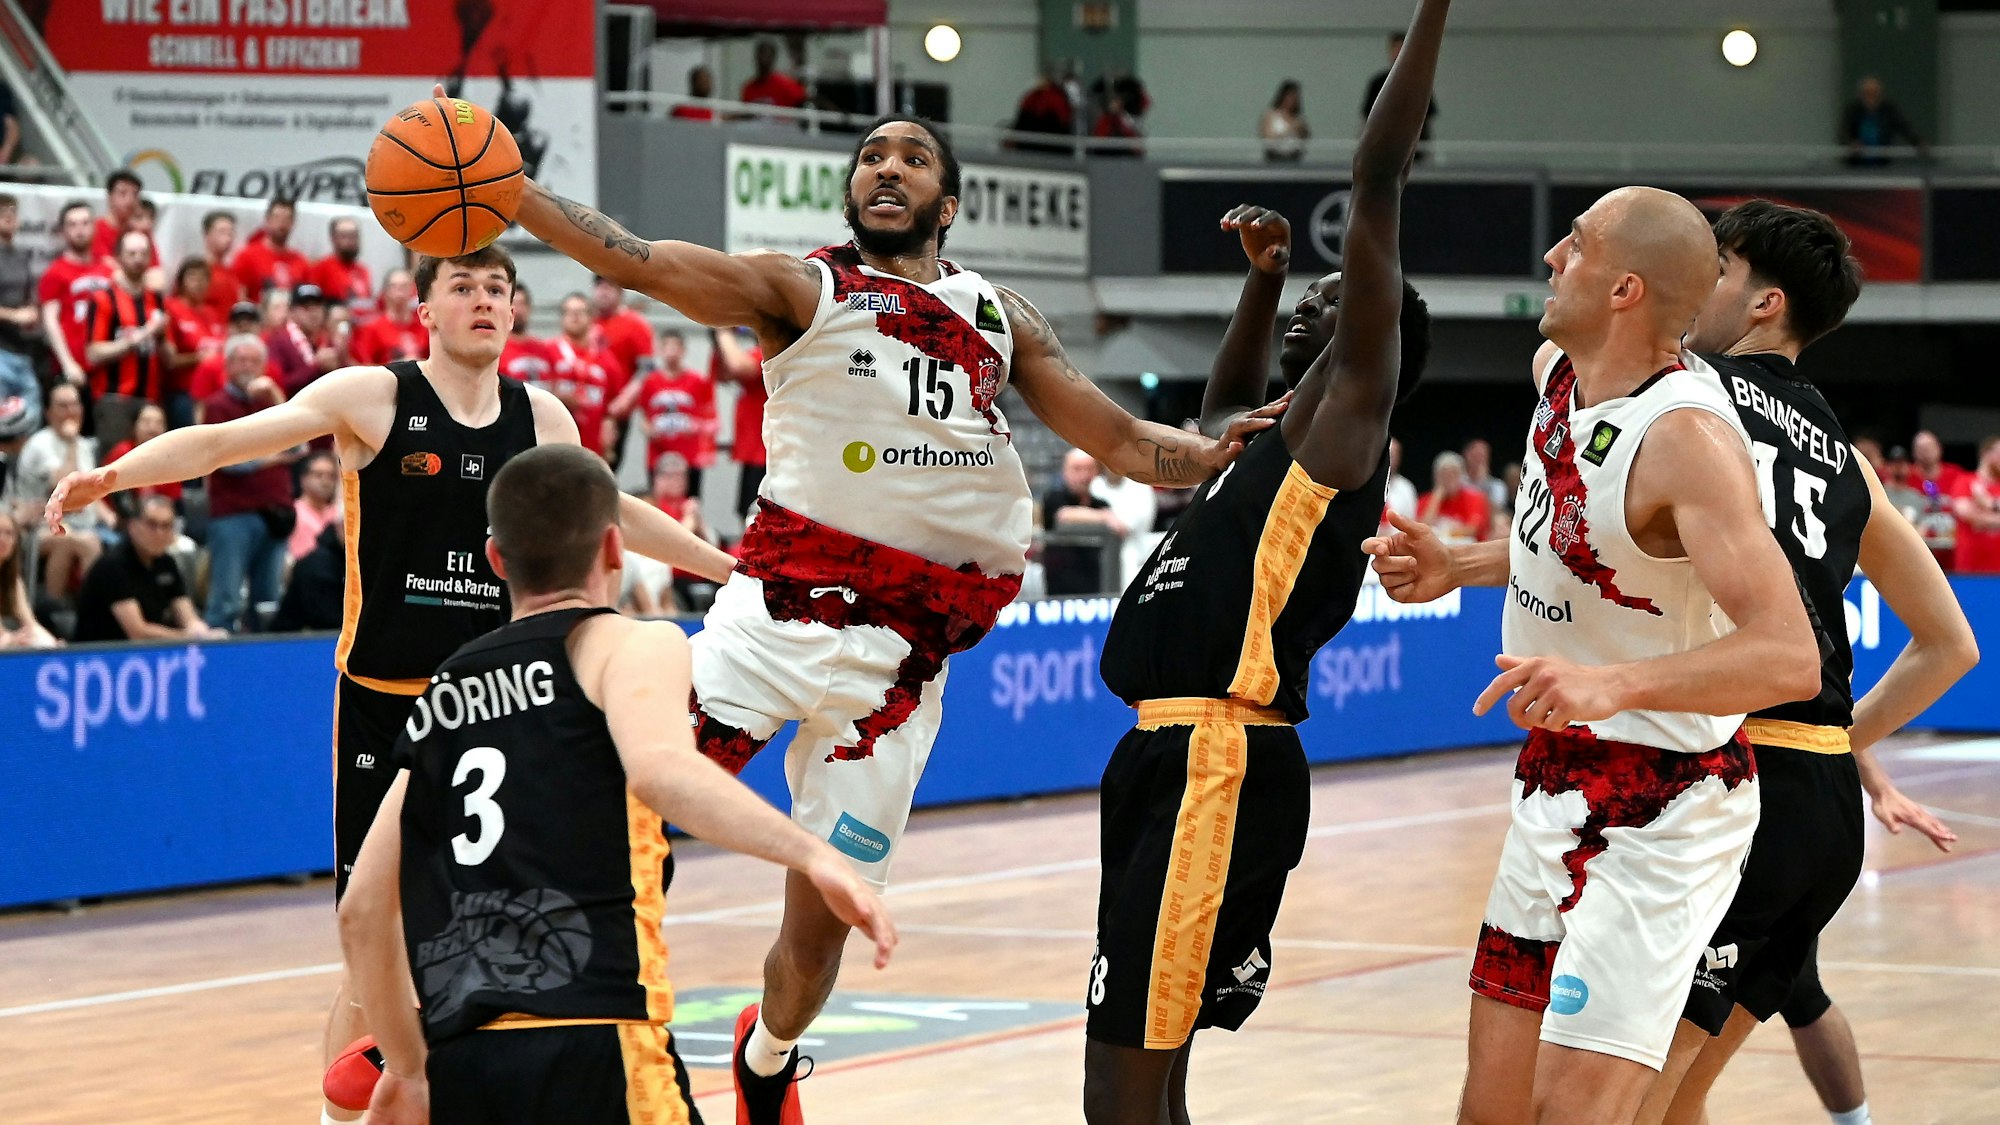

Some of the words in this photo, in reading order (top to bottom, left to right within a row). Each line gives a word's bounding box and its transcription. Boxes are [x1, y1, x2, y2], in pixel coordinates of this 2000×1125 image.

[866, 294, 906, 314] EVL
[848, 366, 877, 378] errea
[902, 356, 955, 421] 15
[1731, 375, 1848, 475] BENNEFELD
[881, 443, 994, 467] orthomol
[1518, 478, 1552, 556] 22
[1752, 440, 1828, 560] 15
[447, 551, 475, 573] ETL
[405, 573, 453, 593] Freund
[991, 635, 1096, 722] sport
[1317, 633, 1401, 712] sport
[35, 645, 206, 749] sport
[406, 660, 555, 743] DÖRING
[450, 746, 507, 867] 3
[838, 823, 884, 851] Barmenia
[1182, 812, 1199, 844] LOK
[1212, 812, 1228, 847] BRN
[1175, 847, 1193, 884] BRN
[1206, 850, 1223, 884] LOK
[1168, 891, 1185, 924] LOK
[1161, 927, 1178, 962] BRN
